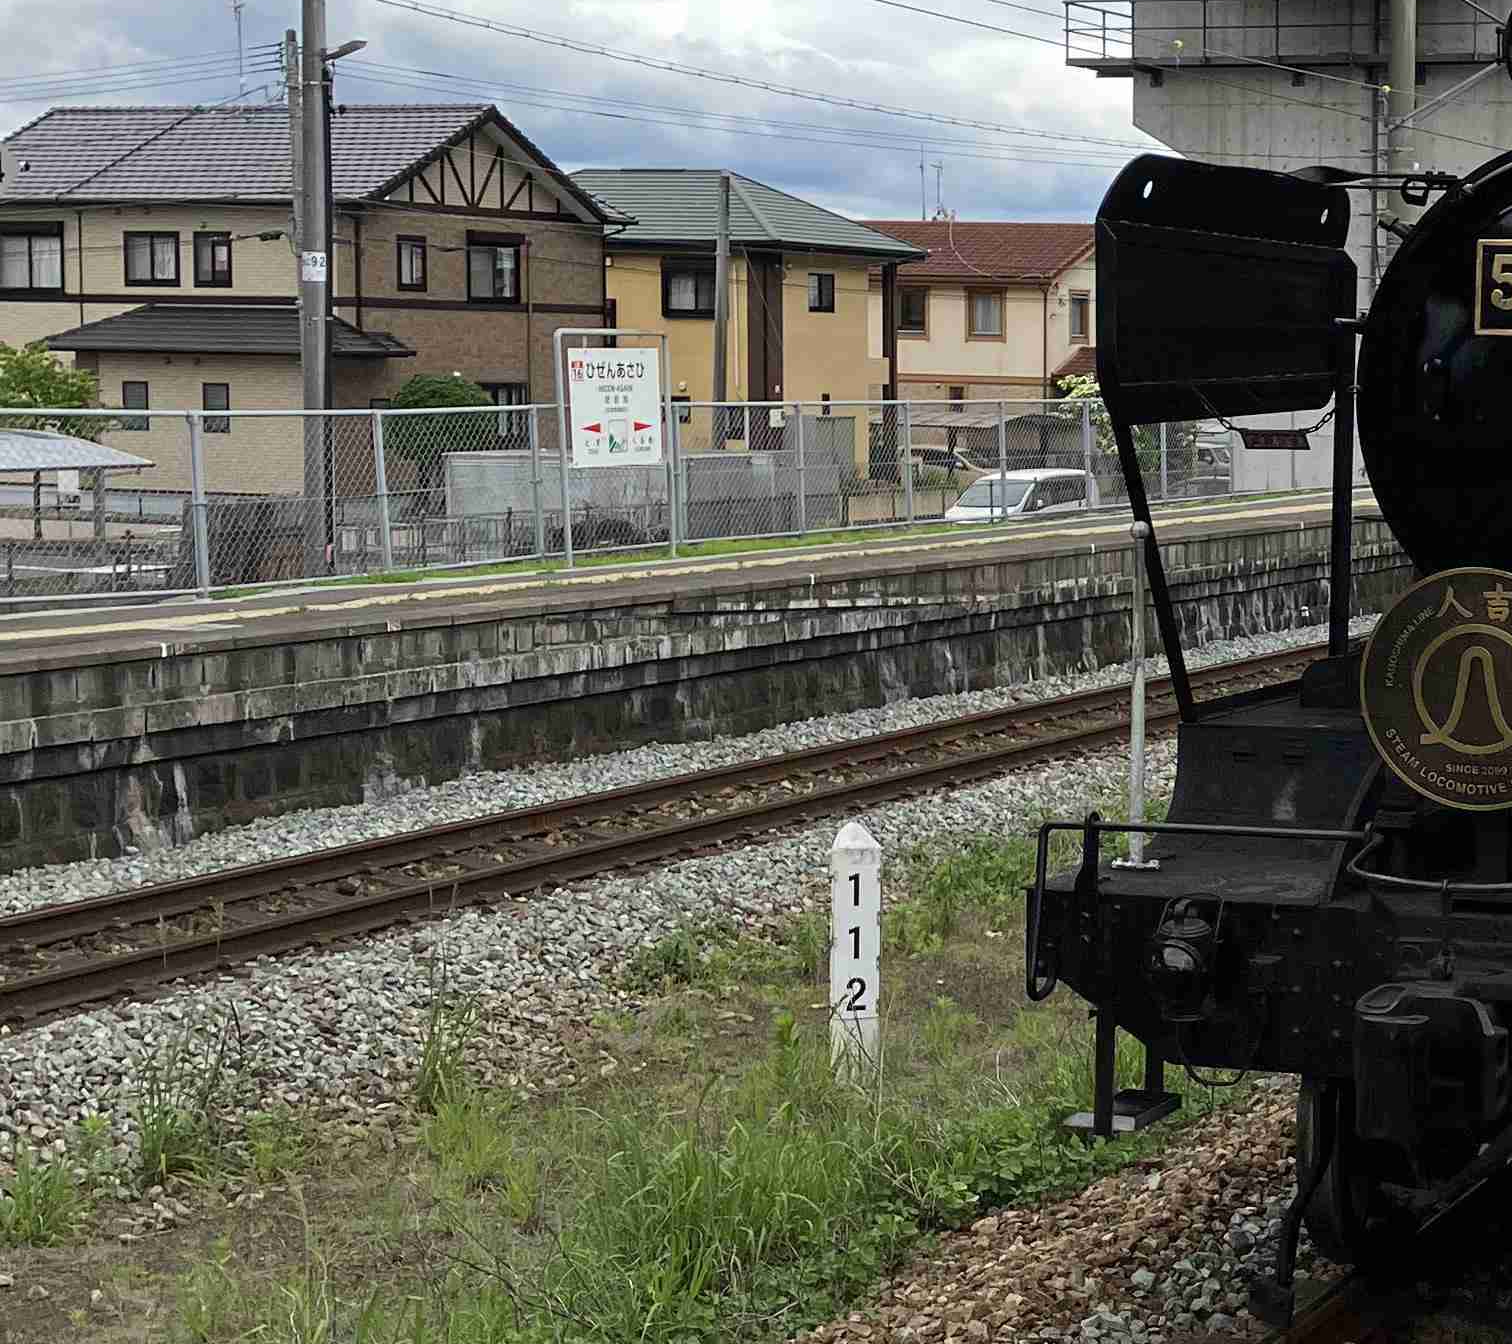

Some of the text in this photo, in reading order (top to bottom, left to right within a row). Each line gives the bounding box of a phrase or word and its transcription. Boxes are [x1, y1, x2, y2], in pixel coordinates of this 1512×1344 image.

[586, 361, 645, 379] ひぜんあさひ
[1384, 728, 1420, 769] STEAM
[1419, 766, 1508, 796] LOCOMOTIVE
[1445, 763, 1480, 775] SINCE
